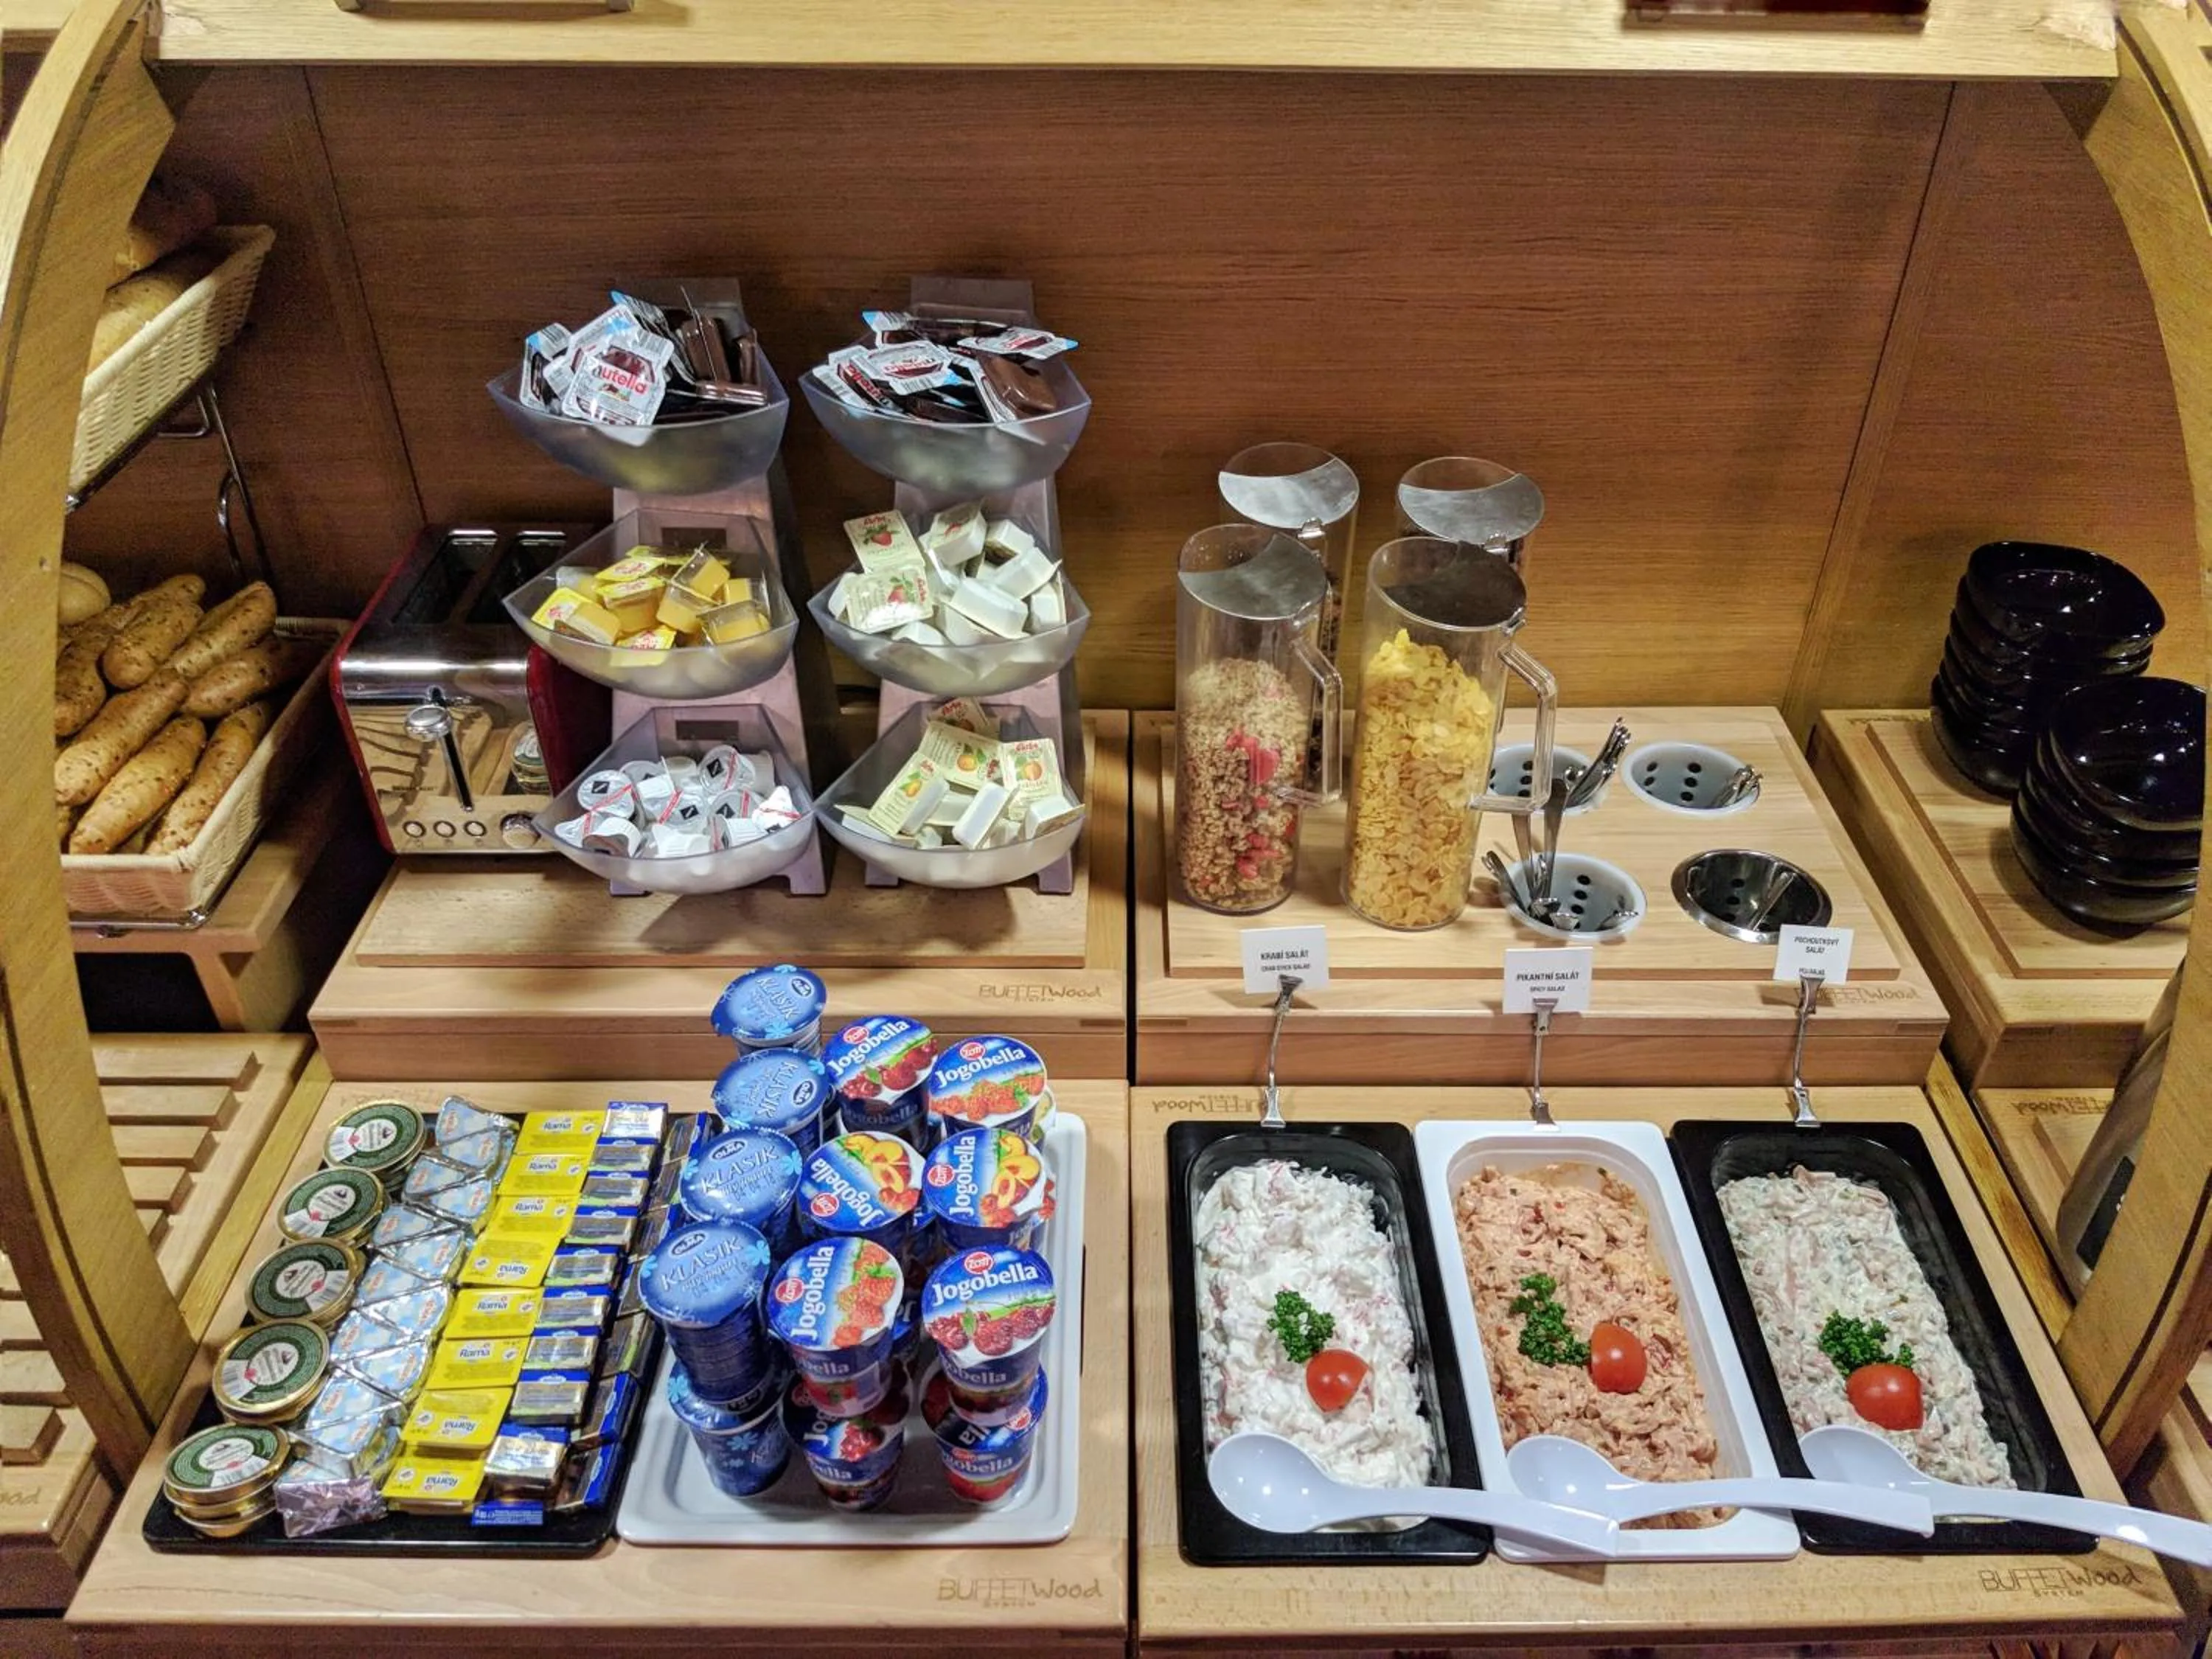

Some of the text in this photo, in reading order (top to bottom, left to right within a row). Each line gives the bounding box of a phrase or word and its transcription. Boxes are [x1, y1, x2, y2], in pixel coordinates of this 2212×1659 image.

[592, 364, 649, 394] nutella
[1285, 948, 1309, 959] SALÁT
[1516, 970, 1579, 981] PIKANTNÍ SALÁT
[827, 1019, 911, 1077] Jogobella
[935, 1046, 1027, 1088] Jogobella
[701, 1144, 779, 1194] KLASIK
[811, 1157, 885, 1227] Jogobella
[949, 1135, 978, 1218] Jogobella
[661, 1237, 742, 1290] KLASIK
[931, 1262, 1039, 1307] Jogobella
[790, 1245, 835, 1341] Jogobella
